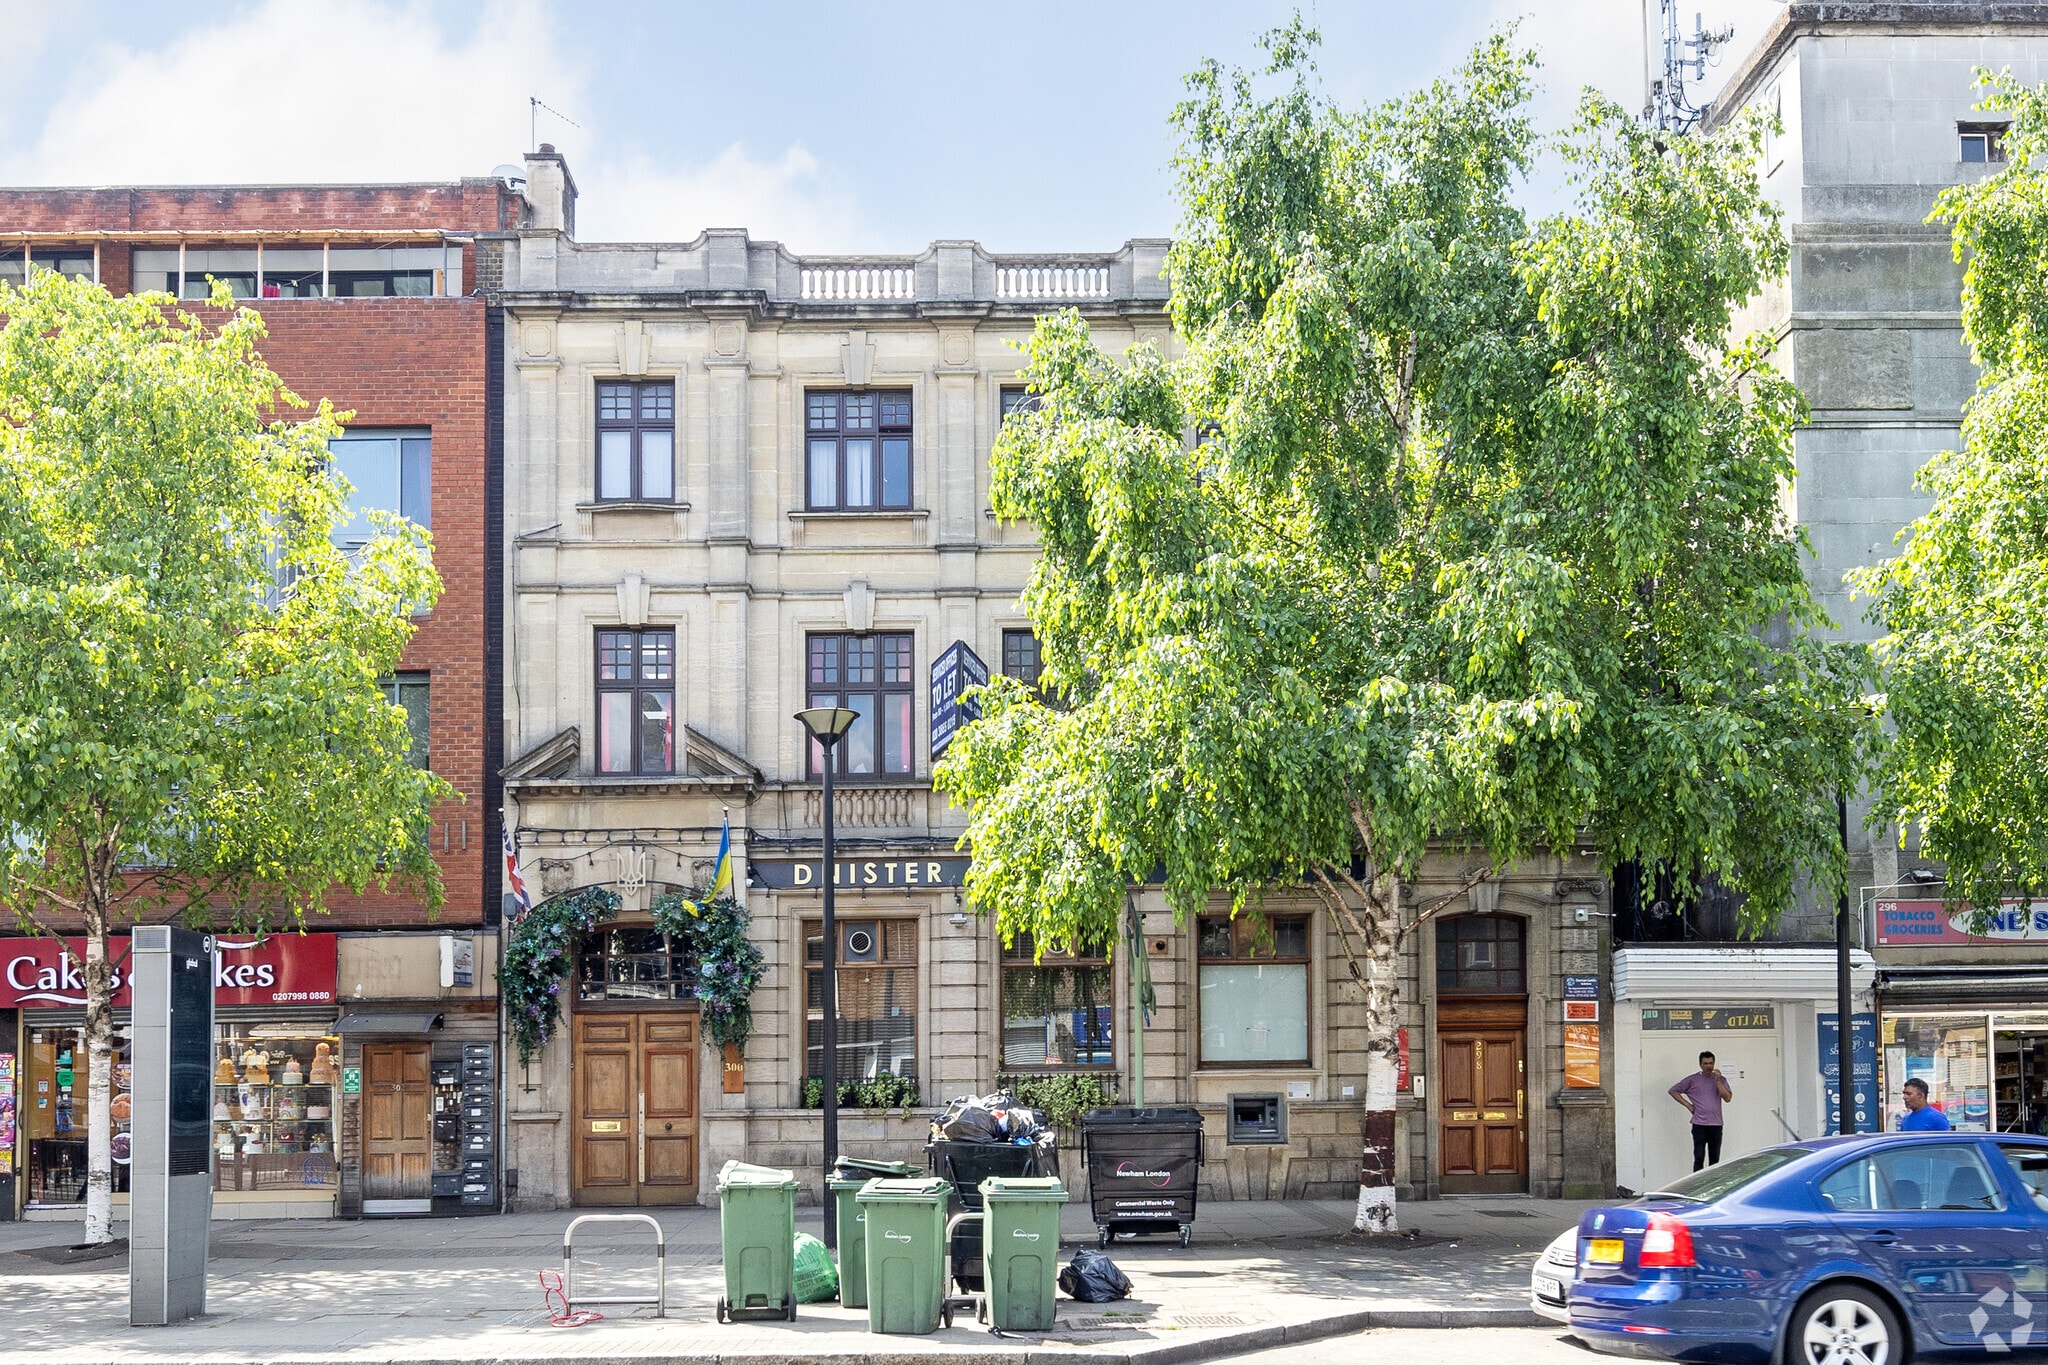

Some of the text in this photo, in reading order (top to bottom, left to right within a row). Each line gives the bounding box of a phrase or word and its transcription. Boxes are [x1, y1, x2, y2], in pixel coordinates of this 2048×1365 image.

[932, 684, 942, 708] TO
[943, 669, 957, 699] LET
[1878, 902, 1897, 911] 296
[1884, 911, 1935, 921] TOBACCO
[1884, 924, 1944, 935] GROCERIES
[6, 952, 120, 991] Caks
[272, 991, 330, 1001] 0207998 0880
[725, 1062, 744, 1072] 300
